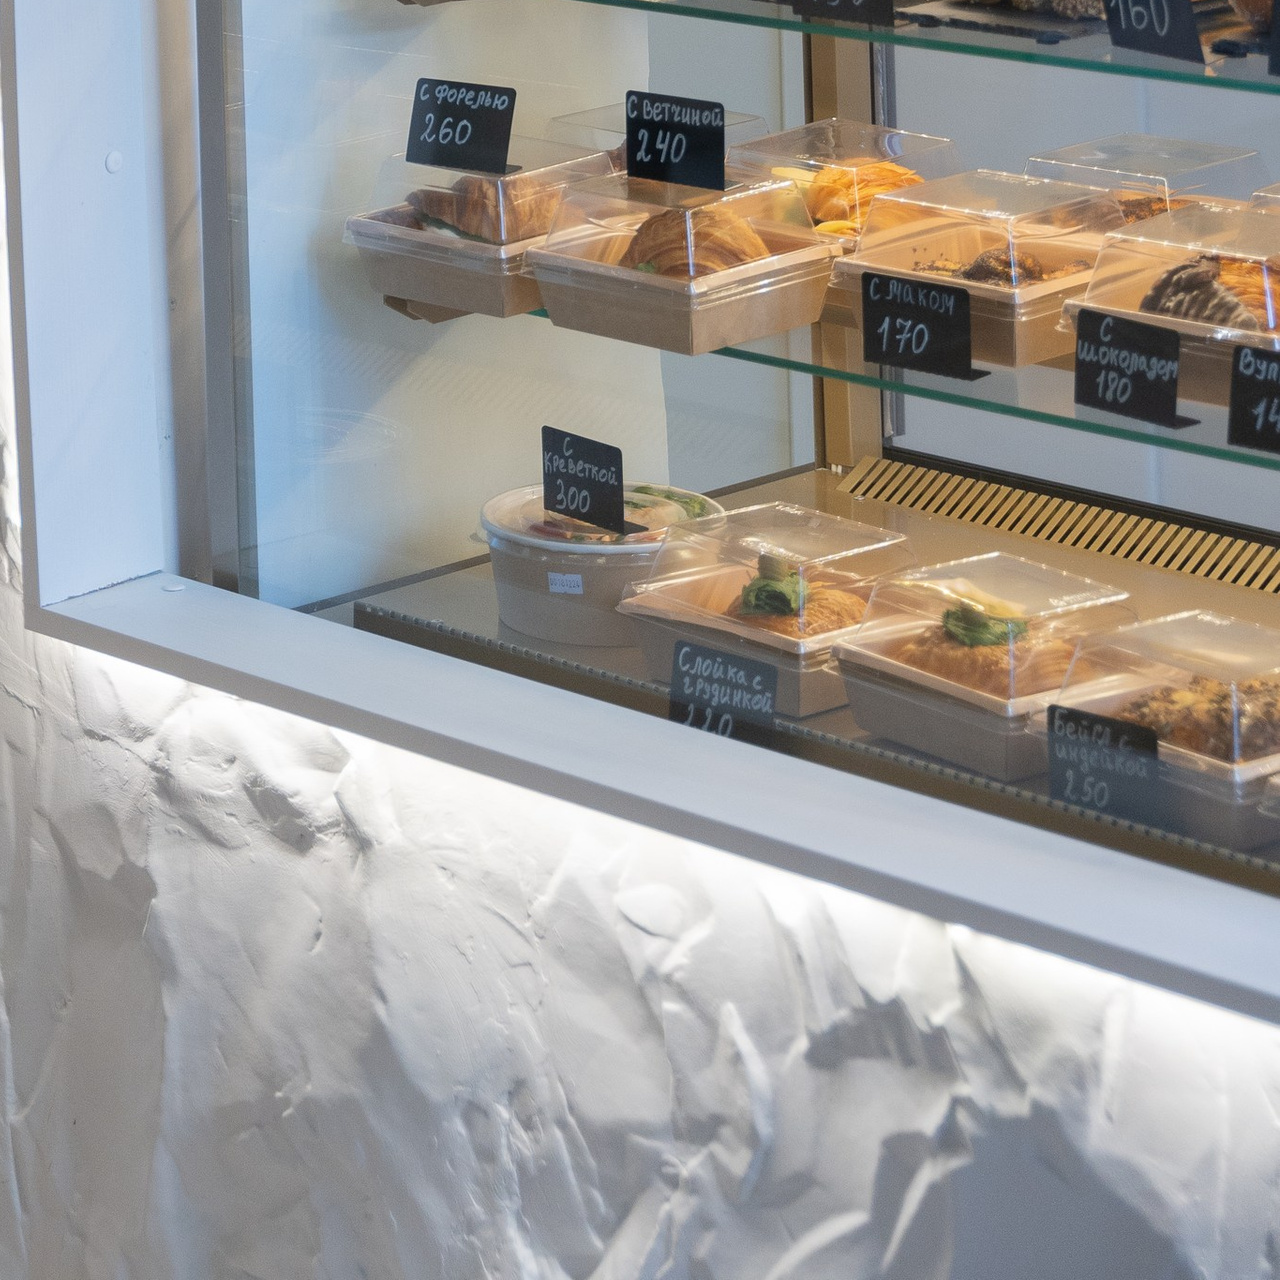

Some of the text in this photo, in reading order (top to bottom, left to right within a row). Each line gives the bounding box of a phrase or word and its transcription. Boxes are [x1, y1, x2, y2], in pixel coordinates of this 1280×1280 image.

[420, 113, 472, 145] 260
[636, 128, 686, 164] 240
[877, 316, 929, 355] 170
[1096, 369, 1132, 403] 180
[1251, 397, 1280, 434] 14
[555, 478, 591, 514] 300
[1063, 768, 1110, 808] 250
